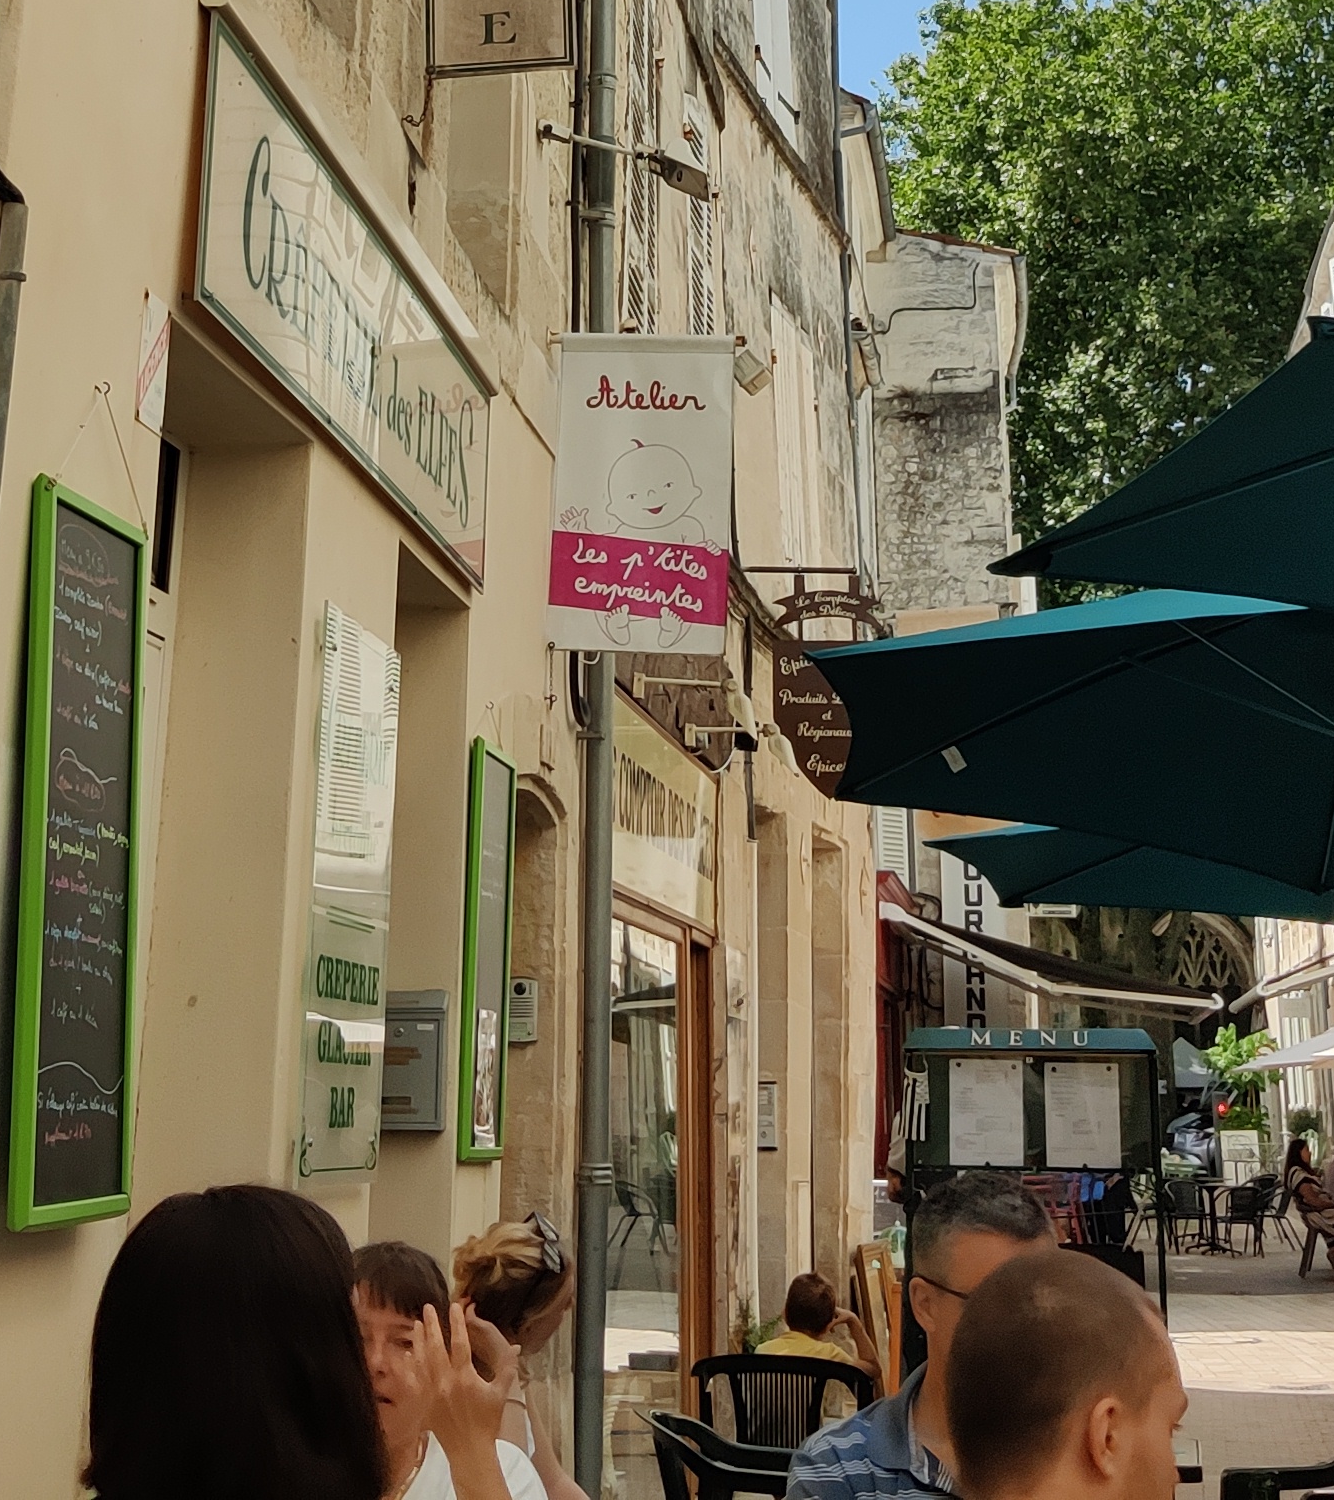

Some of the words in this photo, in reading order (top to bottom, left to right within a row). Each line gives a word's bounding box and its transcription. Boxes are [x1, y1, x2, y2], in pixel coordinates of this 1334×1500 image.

[586, 375, 706, 411] Atelier
[386, 354, 412, 458] des
[416, 385, 474, 529] ELFES
[572, 538, 608, 564] Les
[574, 577, 704, 613] empreintes
[795, 595, 811, 609] Le
[814, 591, 861, 608] Comptoir
[800, 609, 816, 620] des
[819, 604, 857, 619] Délices
[779, 688, 829, 706] Produits
[821, 709, 833, 721] et
[806, 753, 846, 778] Epice
[619, 752, 666, 852] COMPTOIR
[316, 954, 380, 1006] CREPERIE
[970, 1029, 1089, 1047] MENU
[328, 1086, 355, 1129] BAR
